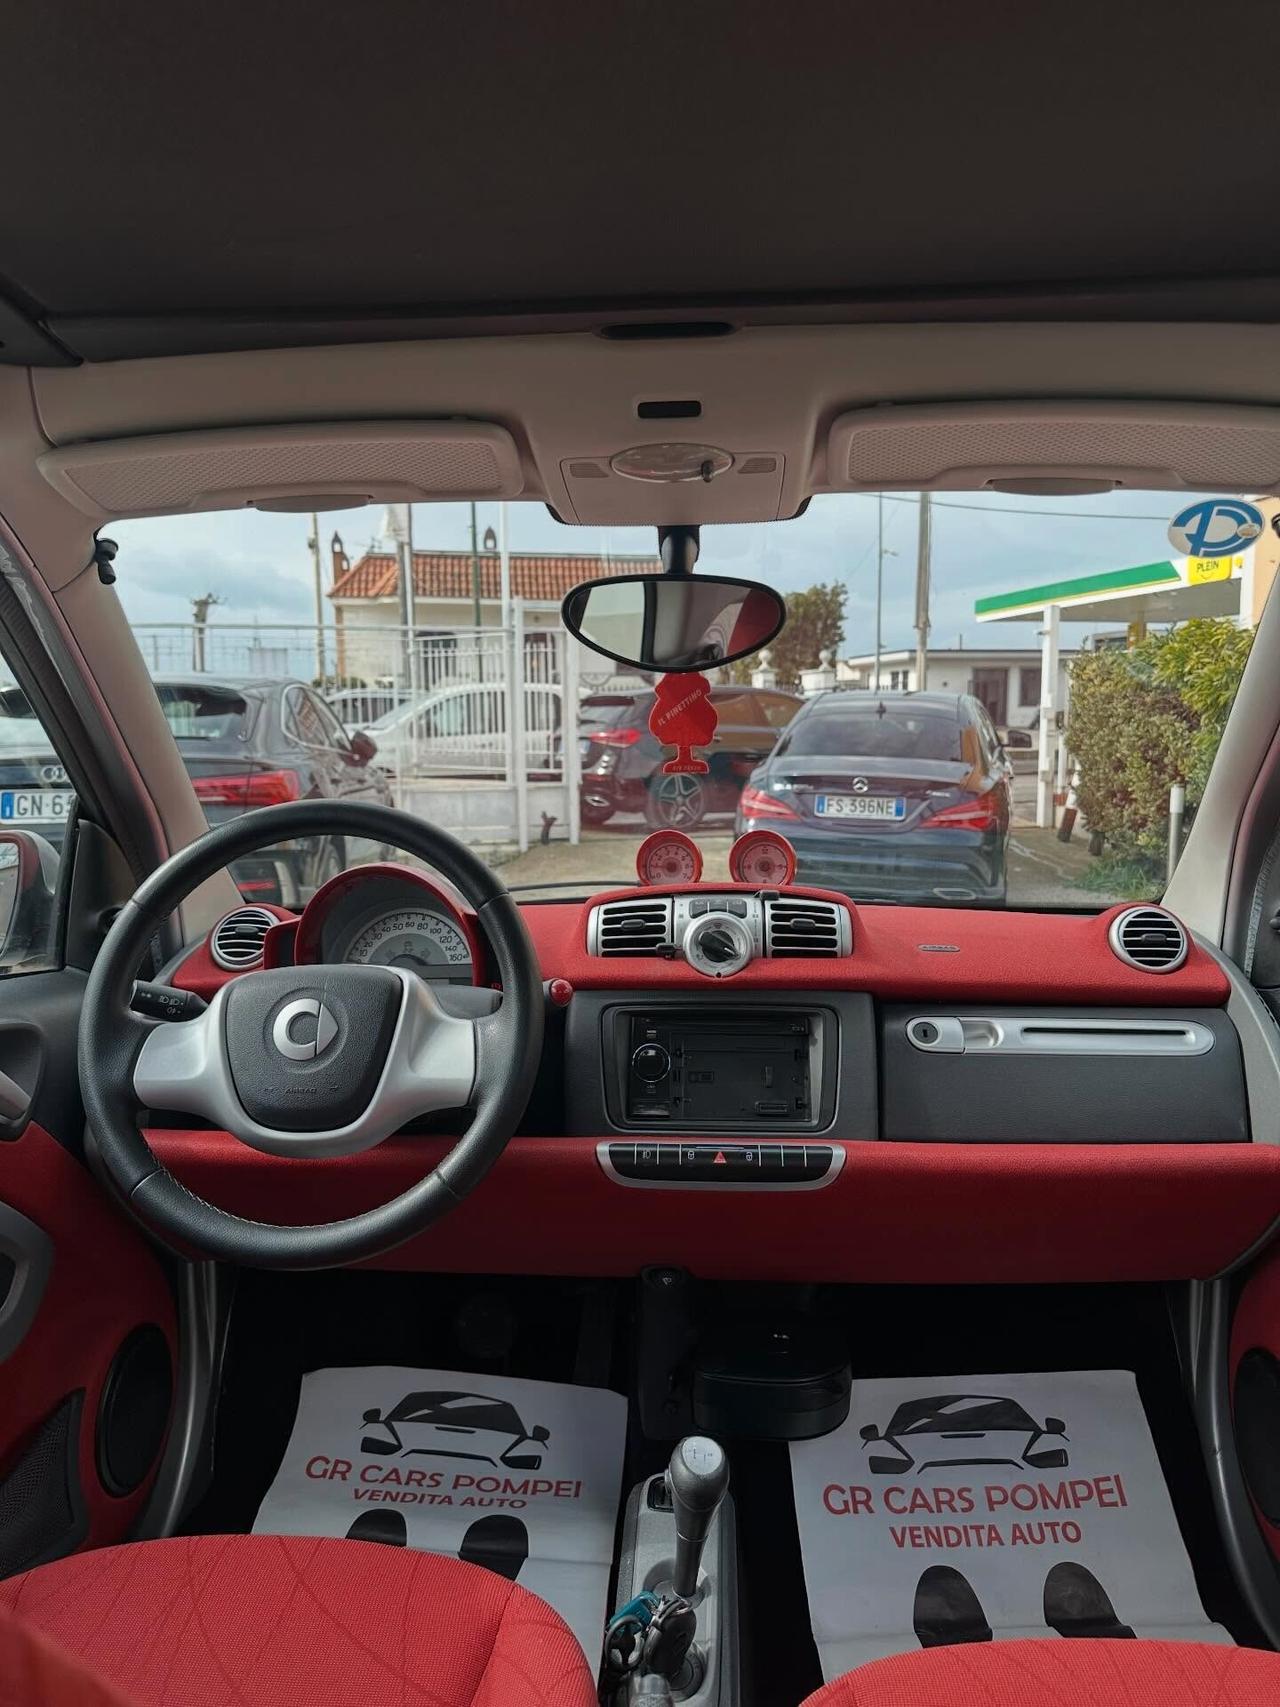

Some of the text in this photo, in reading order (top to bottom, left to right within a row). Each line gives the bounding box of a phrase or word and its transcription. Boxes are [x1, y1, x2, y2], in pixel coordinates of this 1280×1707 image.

[1196, 560, 1220, 573] PLEIN
[17, 795, 43, 816] GN
[826, 800, 895, 816] FS 396NE
[392, 923, 403, 931] 50
[417, 922, 428, 930] 80
[440, 935, 452, 943] 120
[449, 953, 463, 961] 160
[305, 1455, 584, 1498] GR CARS POMPEI
[353, 1487, 528, 1509] VENDITA AUTO
[823, 1474, 1129, 1515] GR CARS POMPEI
[889, 1520, 1082, 1549] VENDITA AUTO
